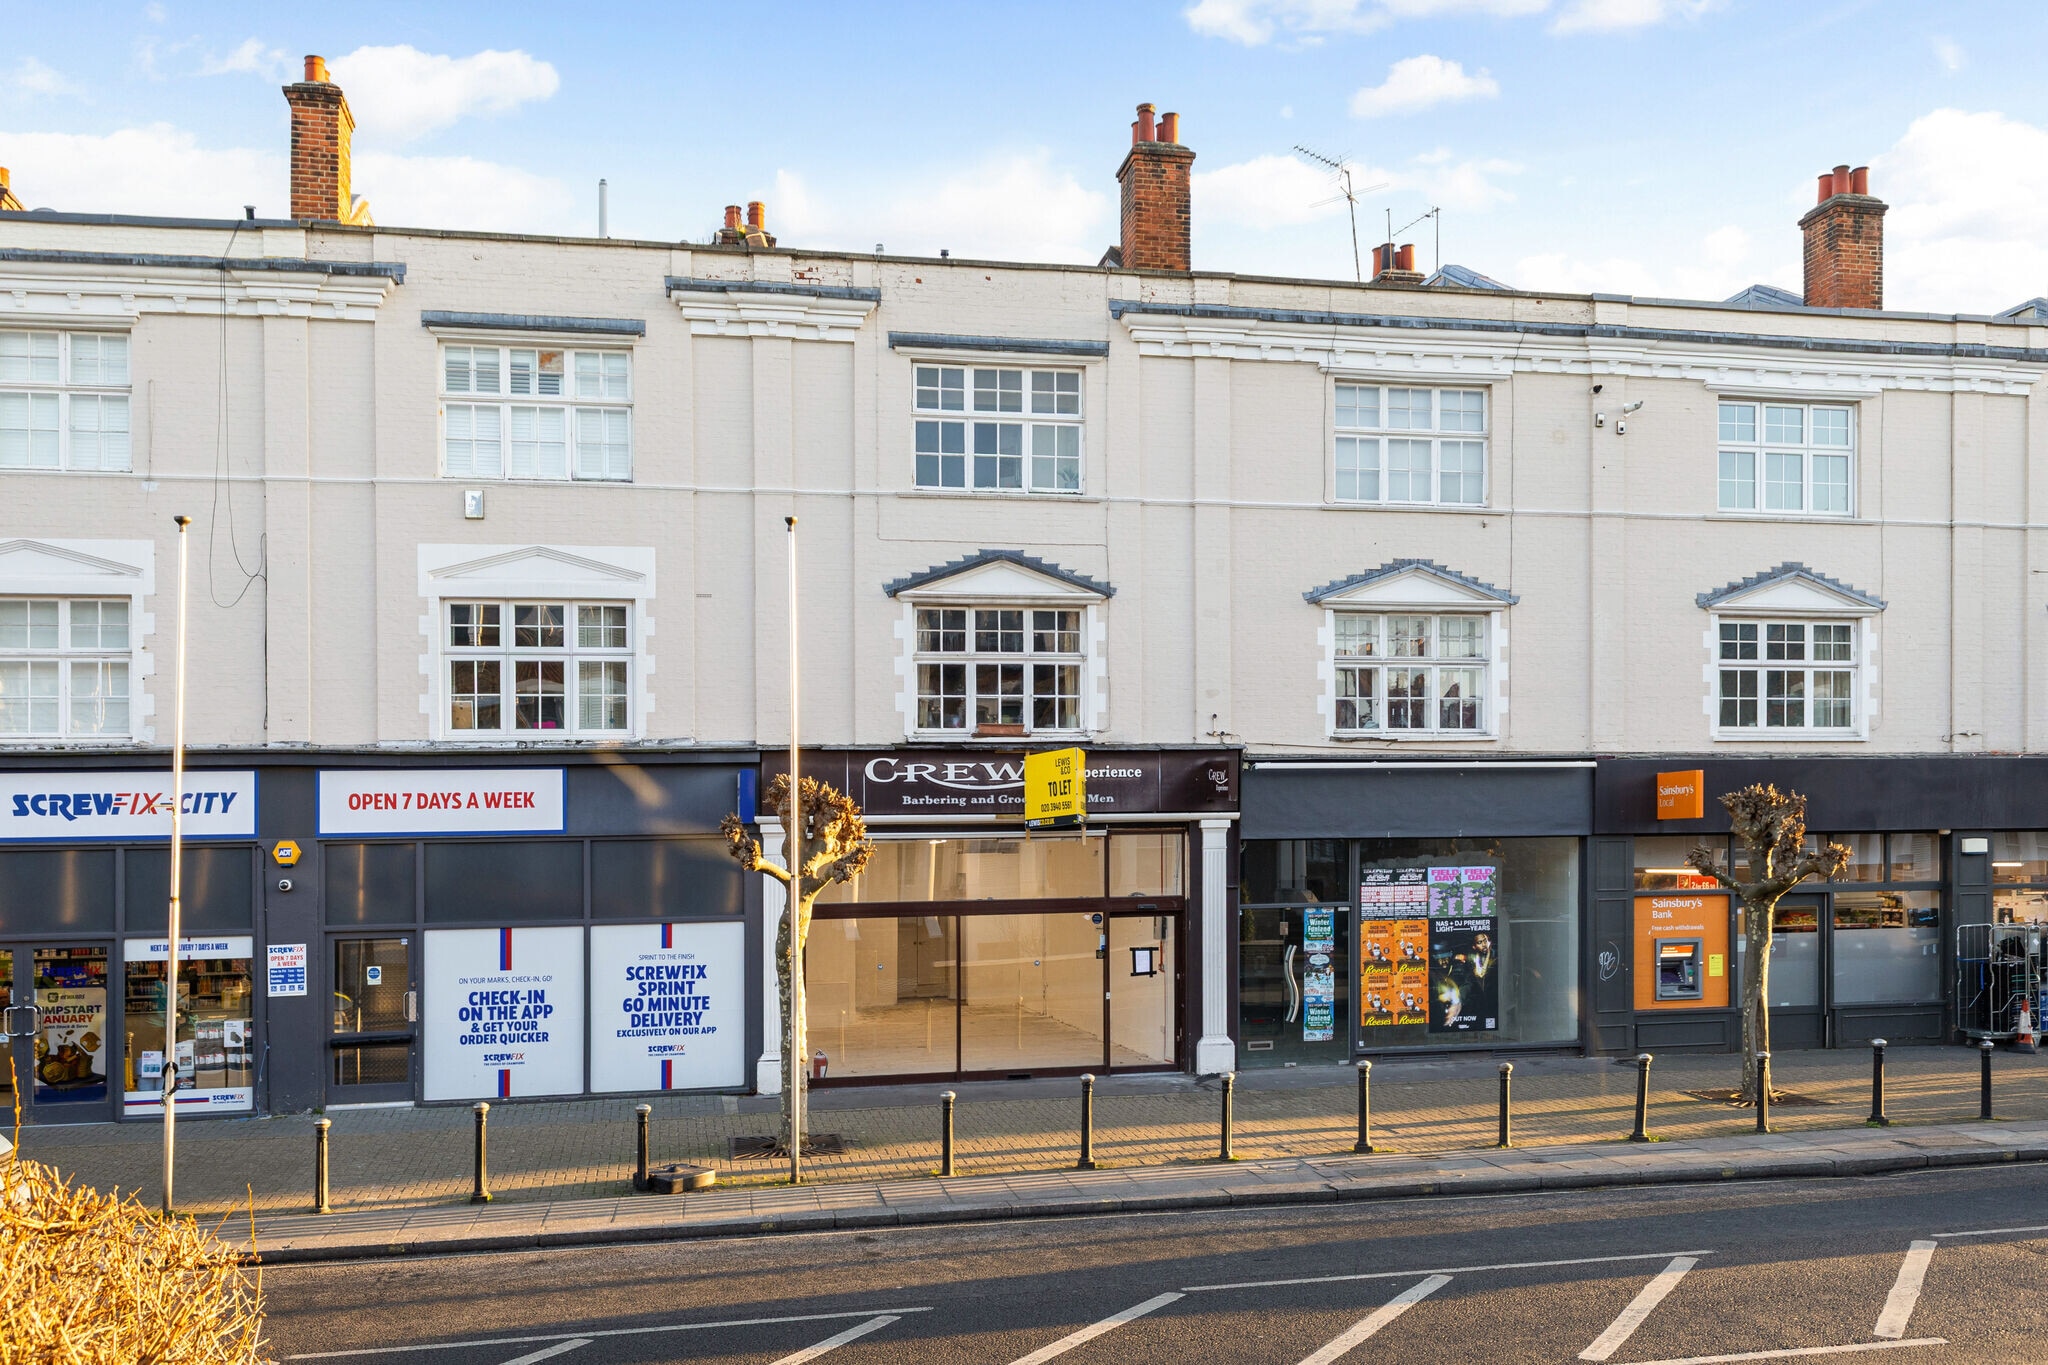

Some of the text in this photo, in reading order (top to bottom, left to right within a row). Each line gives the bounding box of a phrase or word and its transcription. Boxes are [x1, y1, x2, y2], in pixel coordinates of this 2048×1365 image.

[1055, 757, 1070, 767] LEWIS
[865, 758, 1142, 790] CREW perience
[1061, 766, 1070, 775] &CO
[1048, 780, 1072, 796] TO LET
[1660, 784, 1694, 796] Sainsbury's
[348, 792, 535, 810] OPEN 7 DAYS A WEEK
[902, 796, 966, 806] Barbering
[970, 795, 996, 804] and
[1088, 794, 1114, 802] Men
[1660, 796, 1674, 807] Local
[12, 793, 163, 822] SCREWFIX
[1041, 803, 1050, 812] 020
[1050, 802, 1061, 811] 3940
[278, 848, 292, 857] ADT
[1652, 898, 1703, 910] Sainsbury's
[1652, 910, 1672, 918] Bank
[150, 944, 161, 952] NEXT
[269, 946, 304, 954] SCREWFIX
[626, 965, 707, 981] SCREWFIX
[638, 981, 695, 996] SPRINT
[469, 990, 544, 1006] CHECK-IN
[623, 996, 710, 1012] 60 MINUTE
[40, 1014, 94, 1024] ANUARY
[459, 1005, 553, 1022] ON THE APP
[631, 1012, 703, 1028] DELIVERY
[1366, 1017, 1391, 1026] Reese's
[1399, 1016, 1424, 1024] Reese's
[471, 1021, 538, 1033] & GET YOUR
[617, 1028, 667, 1037] EXCLUSIVELY
[682, 1027, 699, 1035] OUR
[701, 1026, 717, 1034] APP
[460, 1032, 549, 1045] ORDER QUICKER
[648, 1044, 685, 1053] SCREWFIX
[484, 1053, 524, 1062] SCREWFIX
[212, 1094, 244, 1102] SCREWFIX
